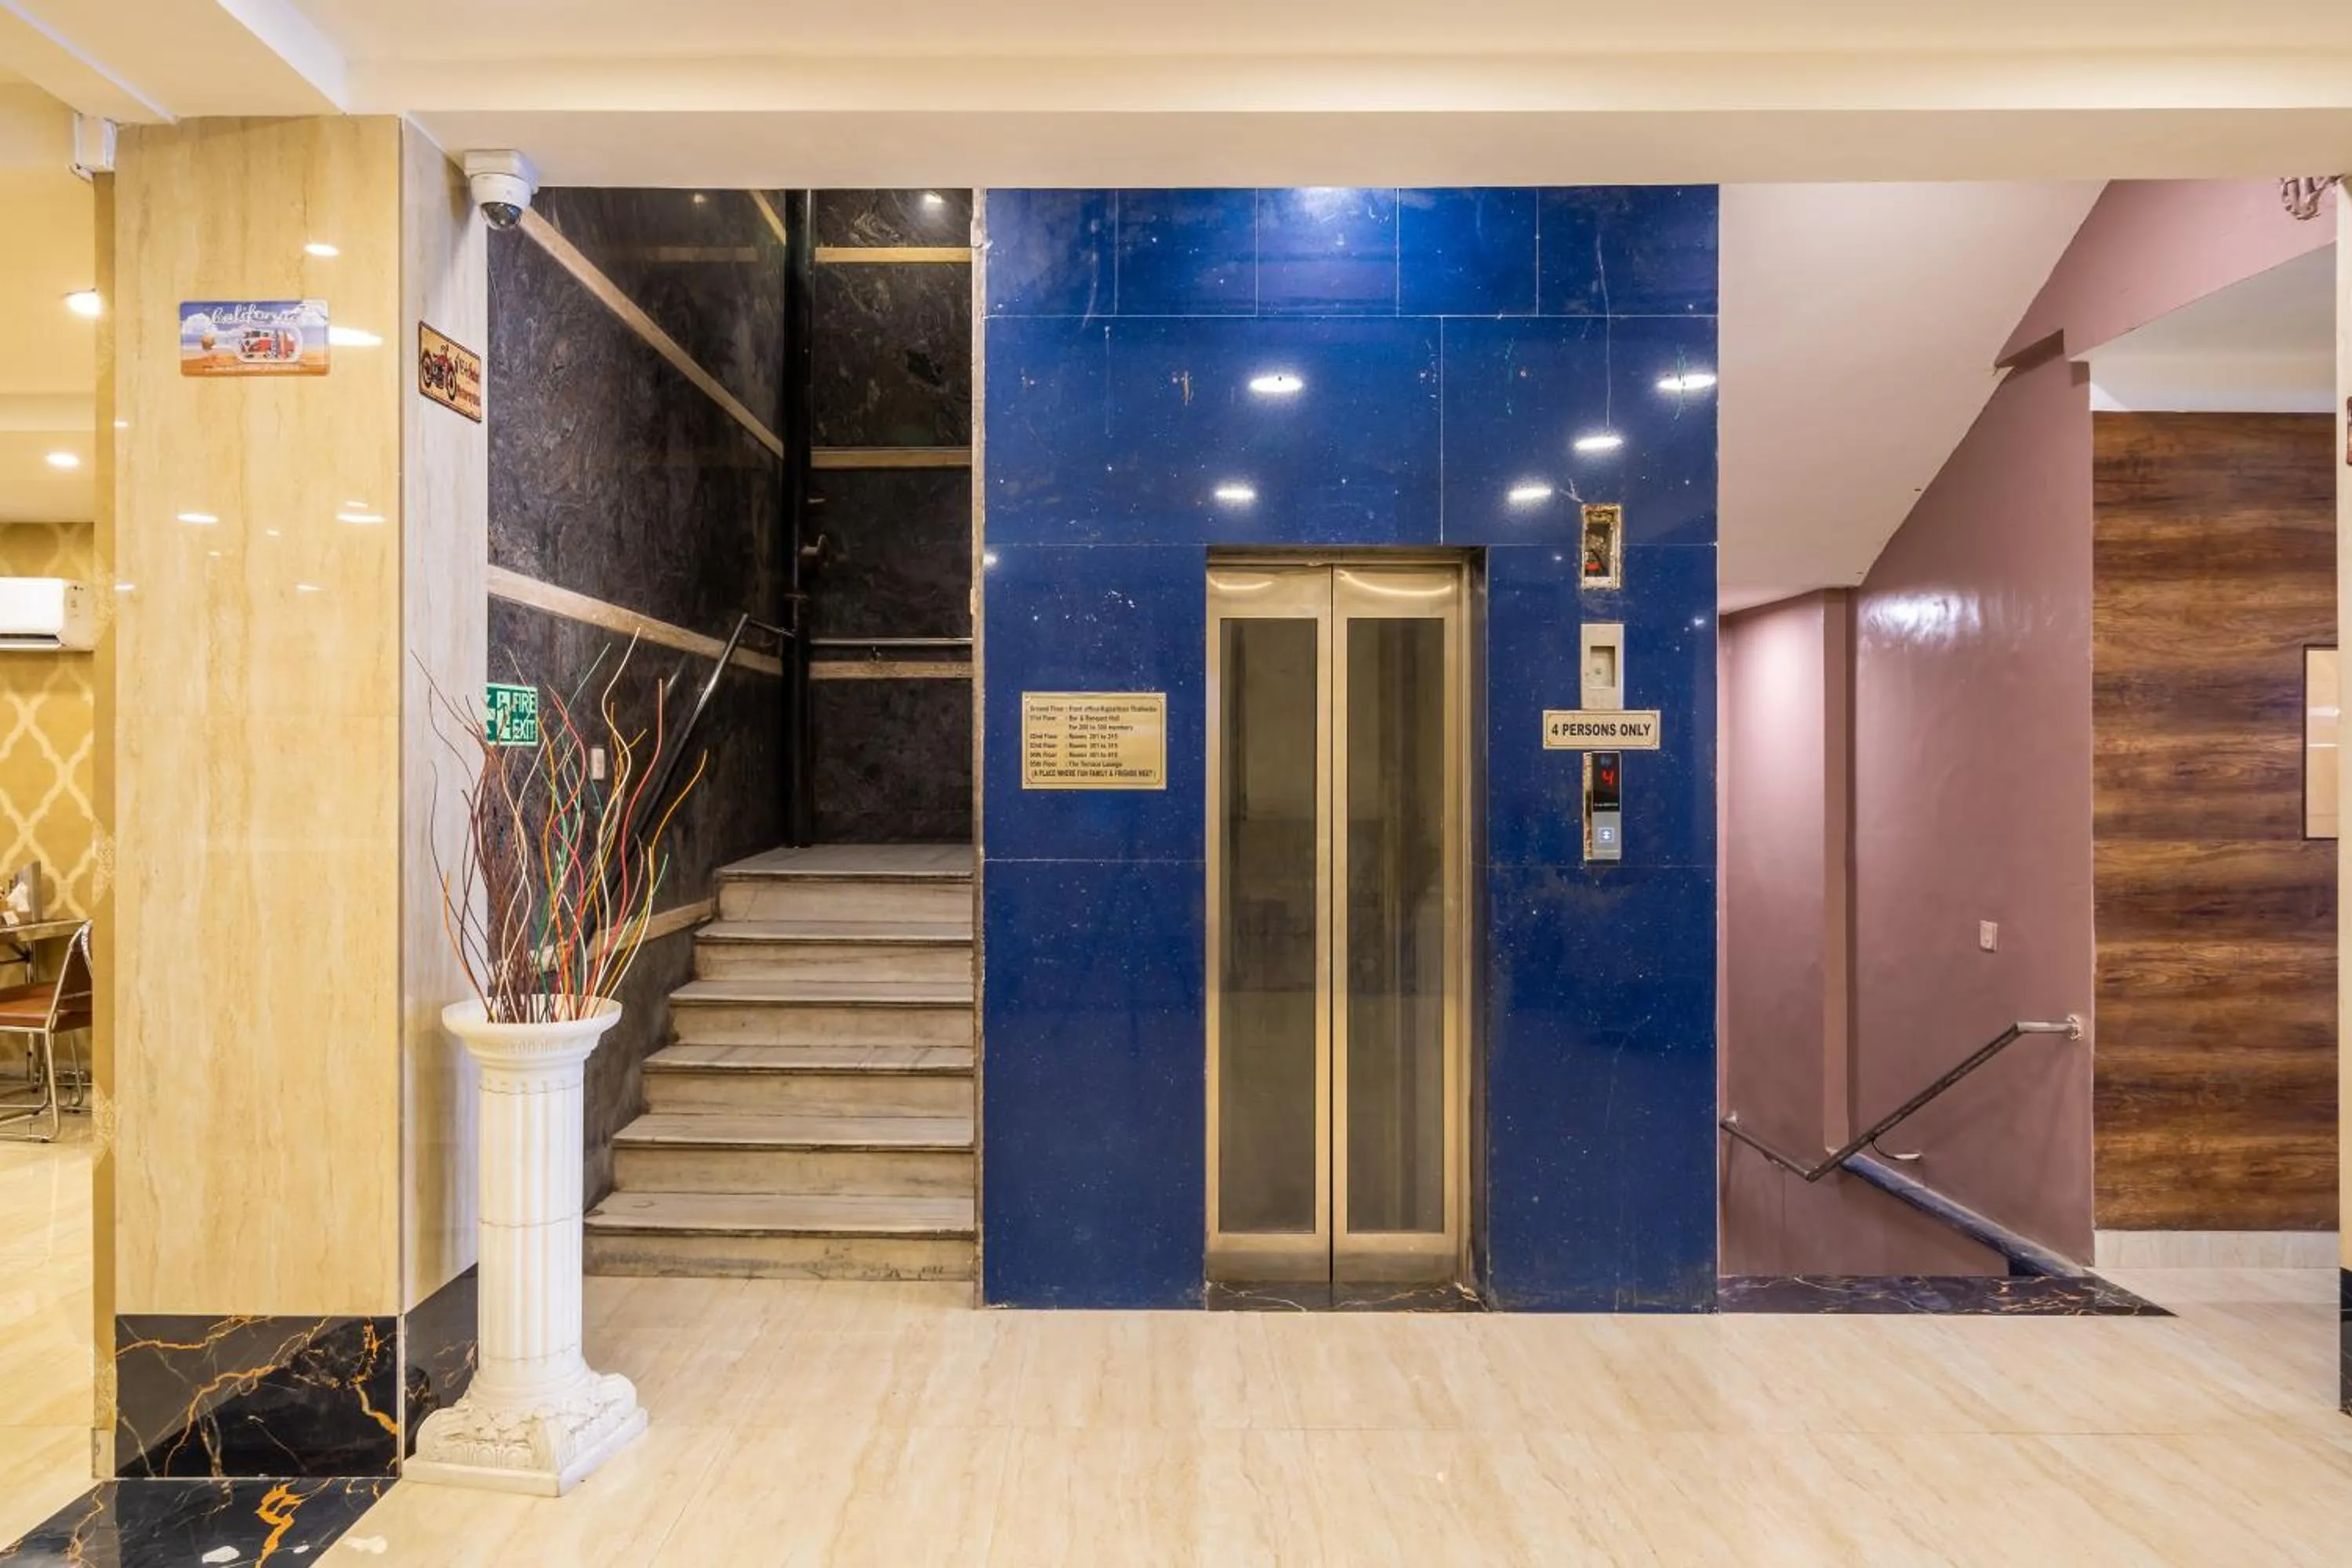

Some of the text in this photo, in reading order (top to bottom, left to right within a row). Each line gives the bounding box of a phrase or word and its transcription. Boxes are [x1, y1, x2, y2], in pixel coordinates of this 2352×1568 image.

[512, 692, 535, 713] FIRE
[512, 719, 535, 740] EXIT
[1552, 723, 1651, 736] 4 PERSONS ONLY
